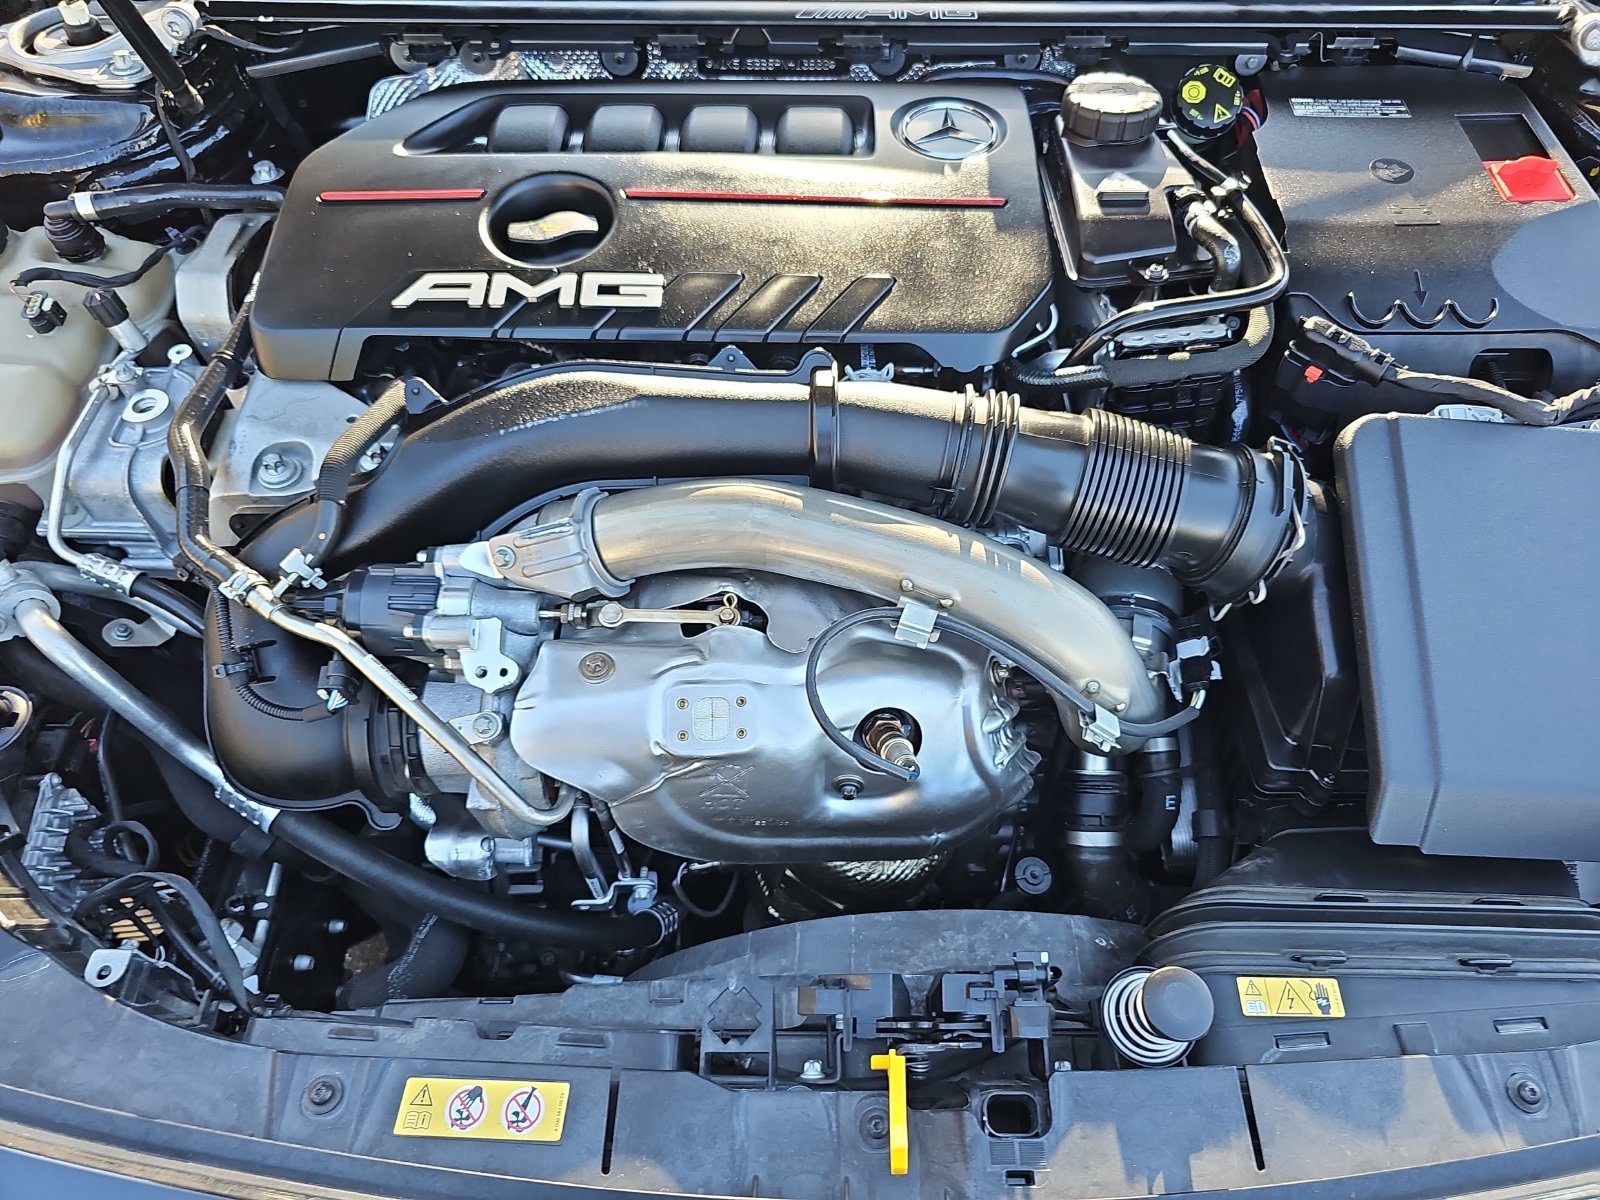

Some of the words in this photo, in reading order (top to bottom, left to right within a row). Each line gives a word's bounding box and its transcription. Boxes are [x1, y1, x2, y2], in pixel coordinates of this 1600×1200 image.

[852, 8, 978, 20] AMG
[391, 272, 665, 308] AMG
[1165, 795, 1176, 810] E
